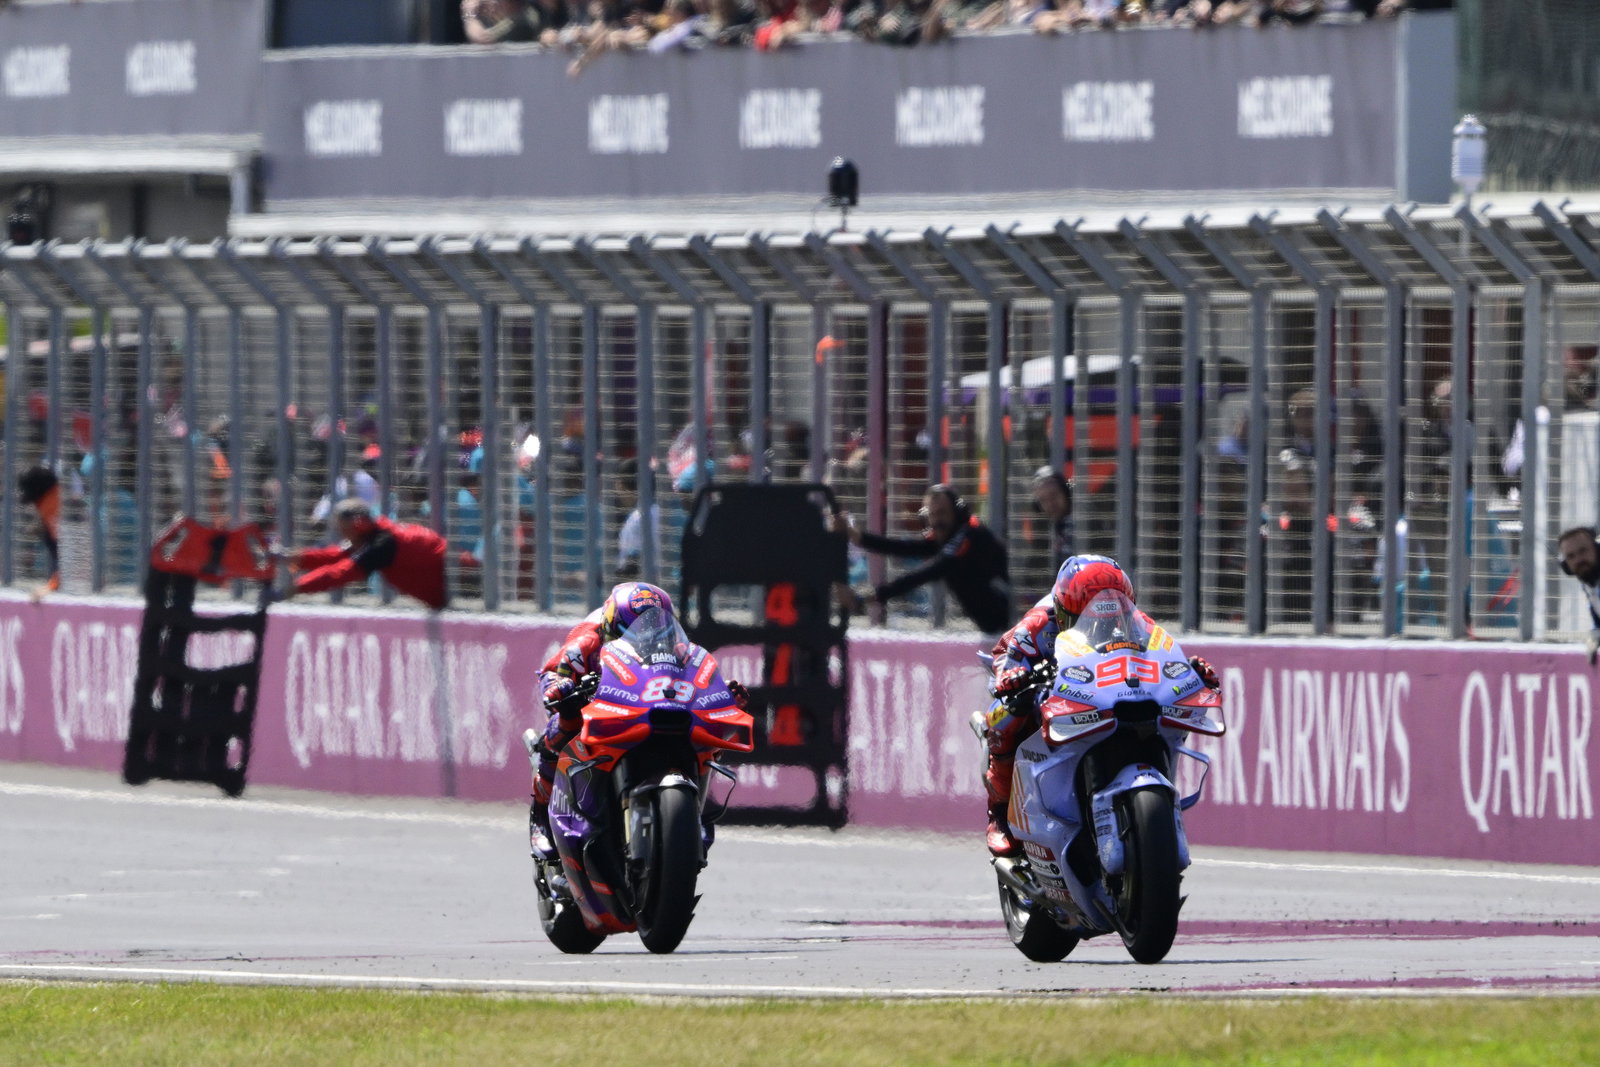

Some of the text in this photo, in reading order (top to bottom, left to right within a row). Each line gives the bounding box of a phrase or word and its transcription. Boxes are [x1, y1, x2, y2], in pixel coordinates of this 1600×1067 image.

[1095, 655, 1161, 688] 93
[599, 685, 640, 702] prima
[643, 675, 696, 703] 89
[696, 690, 731, 708] prima
[1254, 667, 1411, 812] AIRWAYS
[1459, 670, 1593, 833] QATAR
